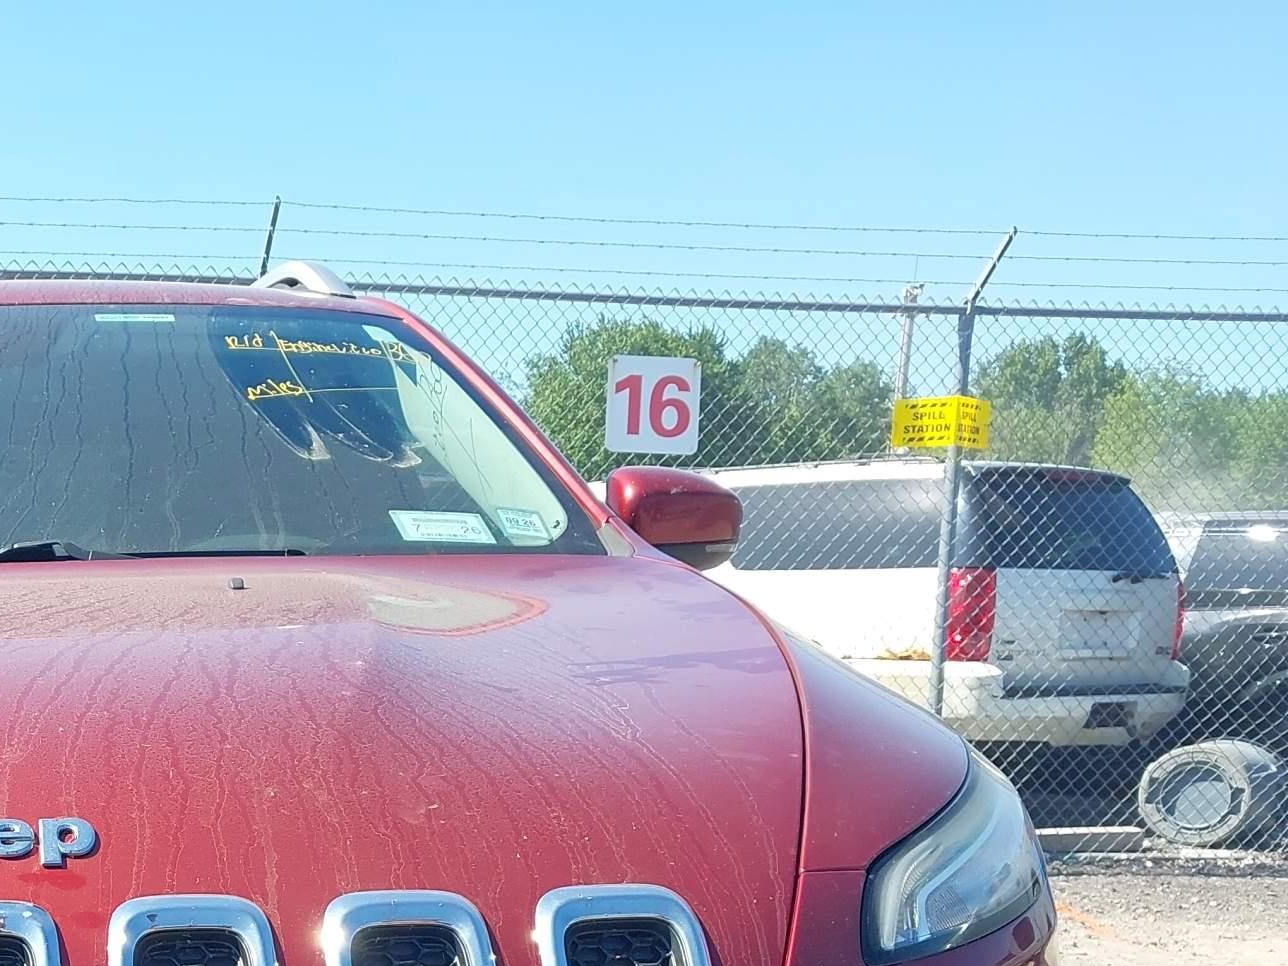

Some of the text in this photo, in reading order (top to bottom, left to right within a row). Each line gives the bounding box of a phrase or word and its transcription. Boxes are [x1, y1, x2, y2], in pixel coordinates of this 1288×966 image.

[246, 378, 304, 402] Miles
[613, 373, 692, 439] 16
[911, 410, 946, 422] SPILL
[902, 423, 952, 435] STATION
